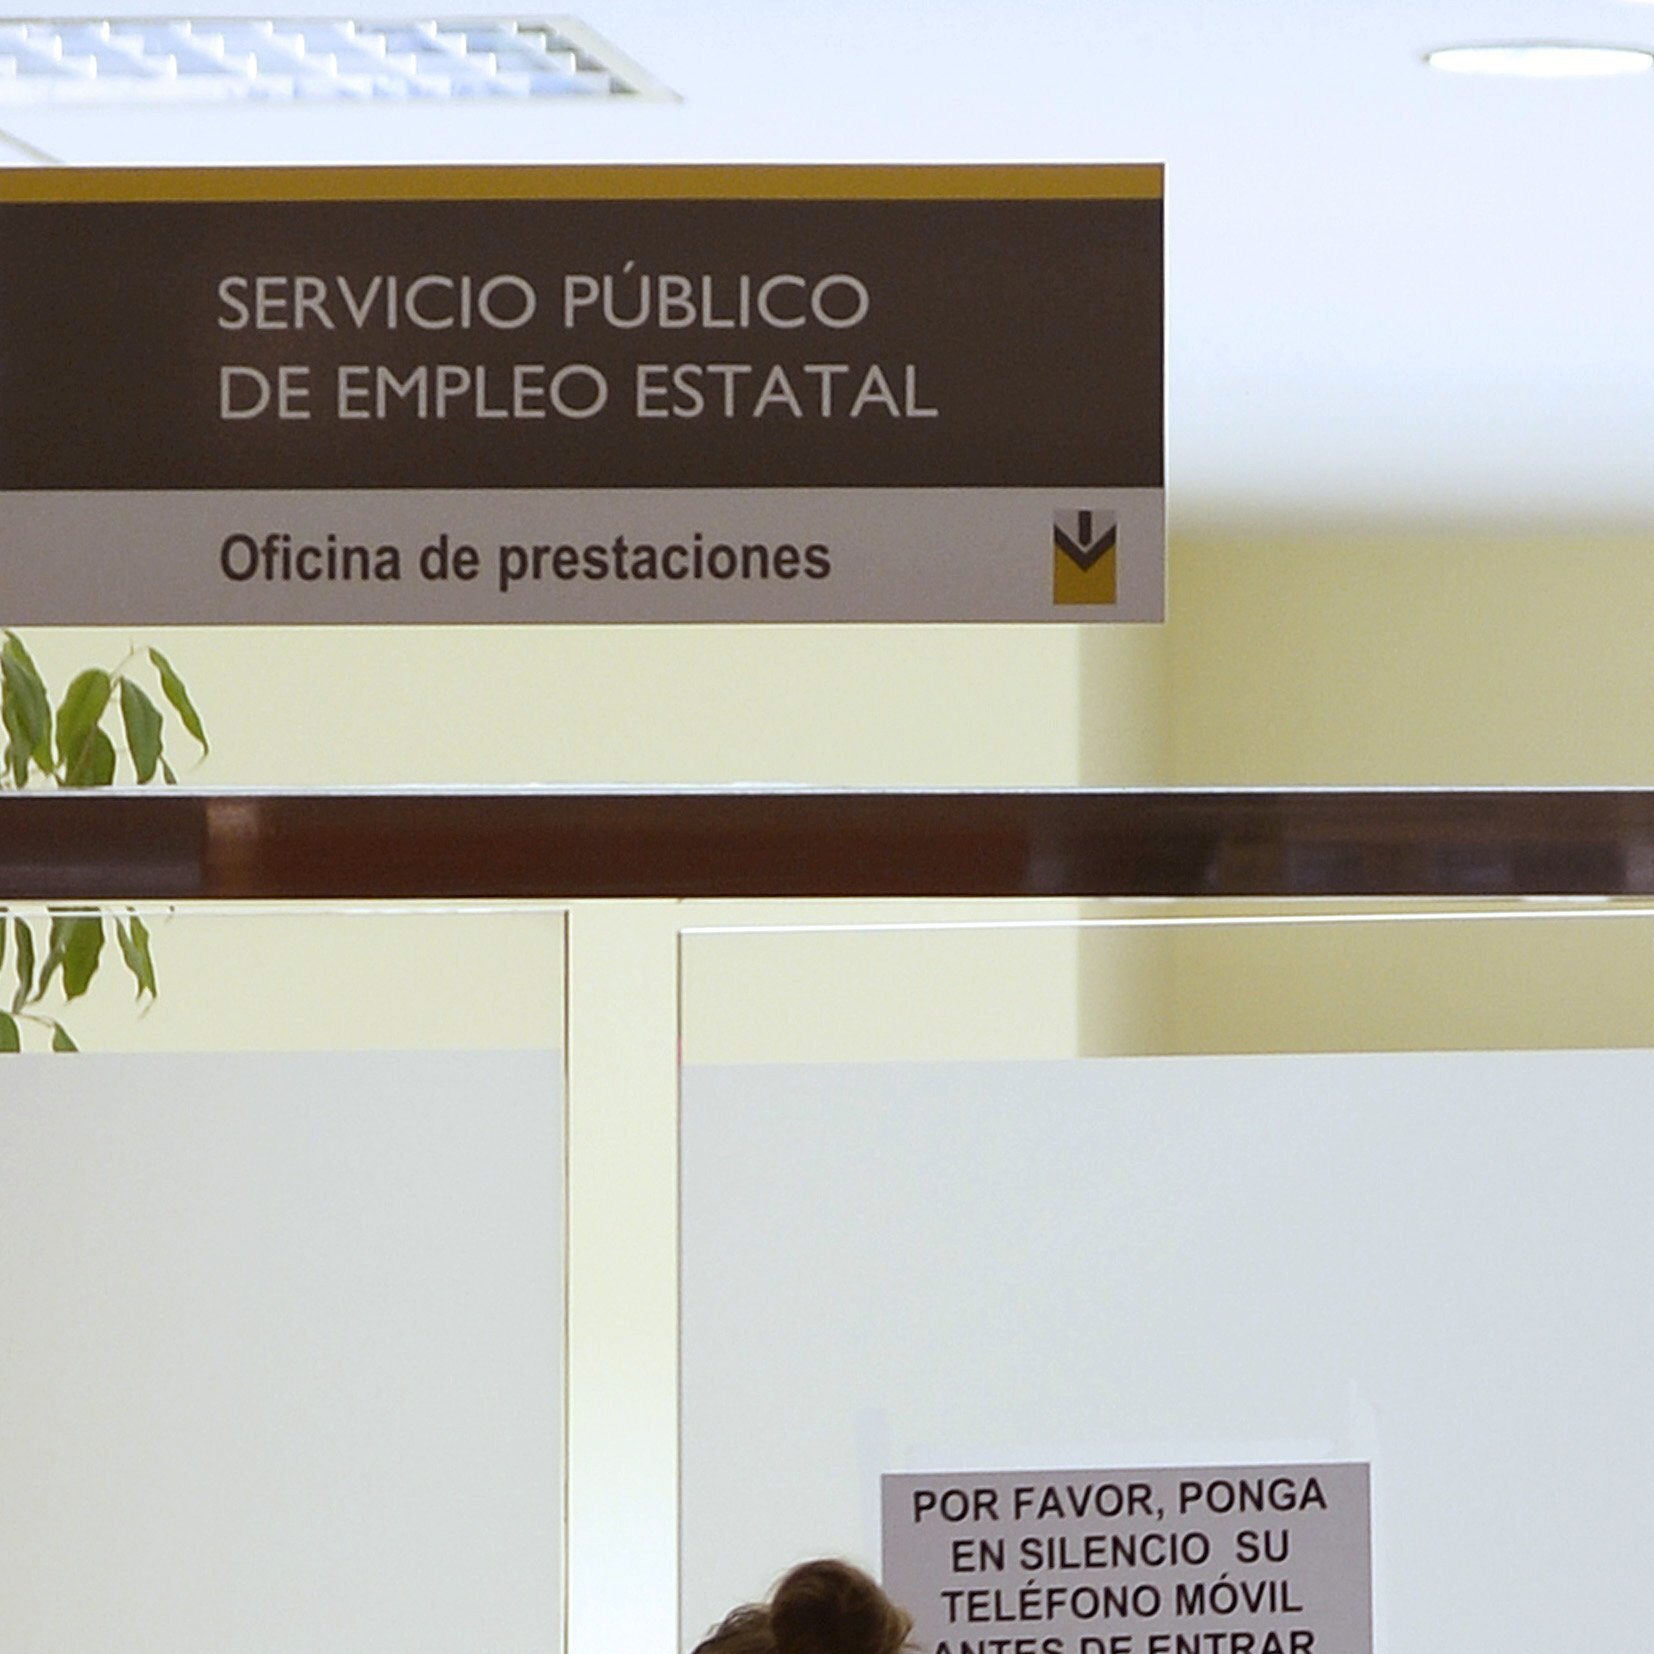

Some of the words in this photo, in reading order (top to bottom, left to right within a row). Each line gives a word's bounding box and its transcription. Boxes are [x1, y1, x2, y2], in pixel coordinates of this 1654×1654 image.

[218, 275, 536, 329] SERVICIO
[565, 261, 869, 328] PÚBLICO
[221, 366, 310, 419] DE
[338, 365, 607, 418] EMPLEO
[637, 364, 938, 417] ESTATAL
[221, 534, 400, 581] Oficina
[420, 534, 479, 580] de
[500, 533, 830, 593] prestaciones
[914, 1489, 998, 1522] POR
[1015, 1484, 1163, 1520] FAVOR,
[1180, 1478, 1327, 1514] PONGA
[953, 1539, 1004, 1572] EN
[1021, 1532, 1209, 1570] SILENCIO
[1237, 1530, 1288, 1563] SU
[941, 1579, 1160, 1623] TELÉFONO
[1176, 1573, 1302, 1615] MÓVIL
